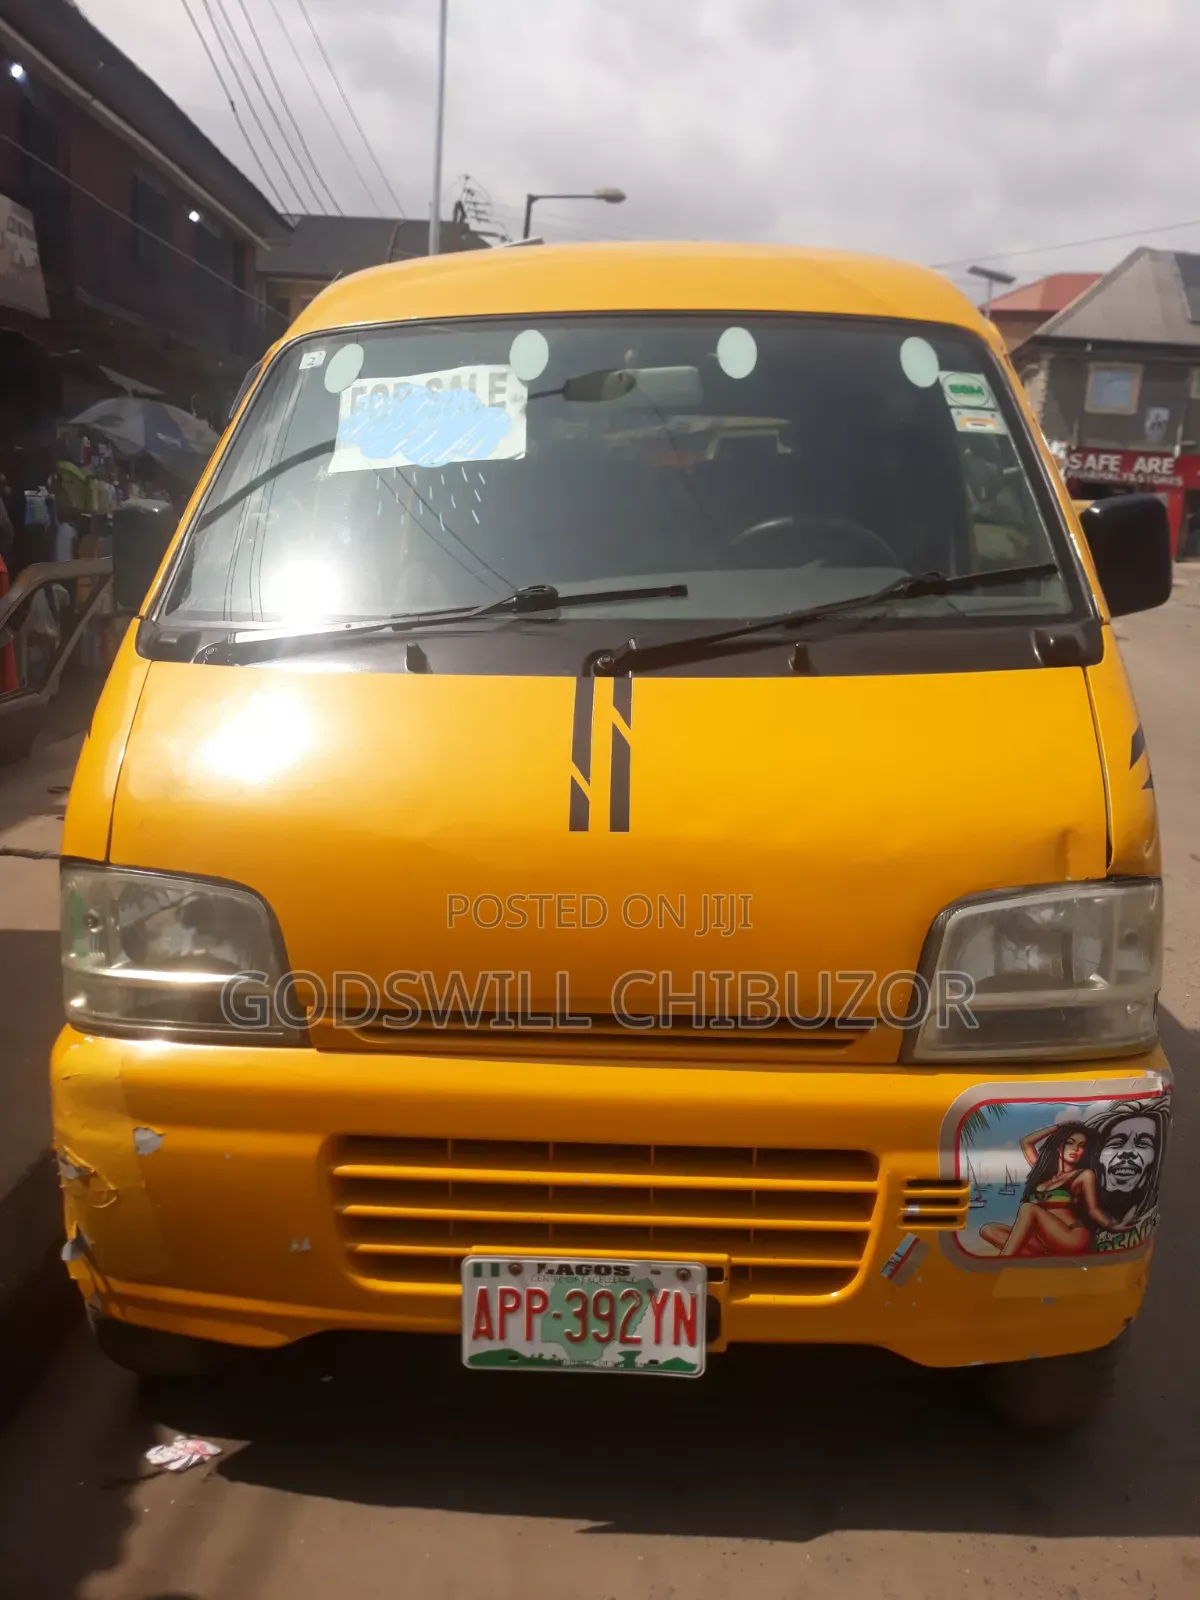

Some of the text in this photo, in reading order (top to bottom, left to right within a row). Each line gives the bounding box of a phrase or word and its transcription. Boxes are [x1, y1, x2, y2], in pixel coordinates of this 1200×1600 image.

[306, 356, 316, 366] 2
[1067, 453, 1176, 475] SAFE ARE
[537, 1263, 631, 1276] LAGOS
